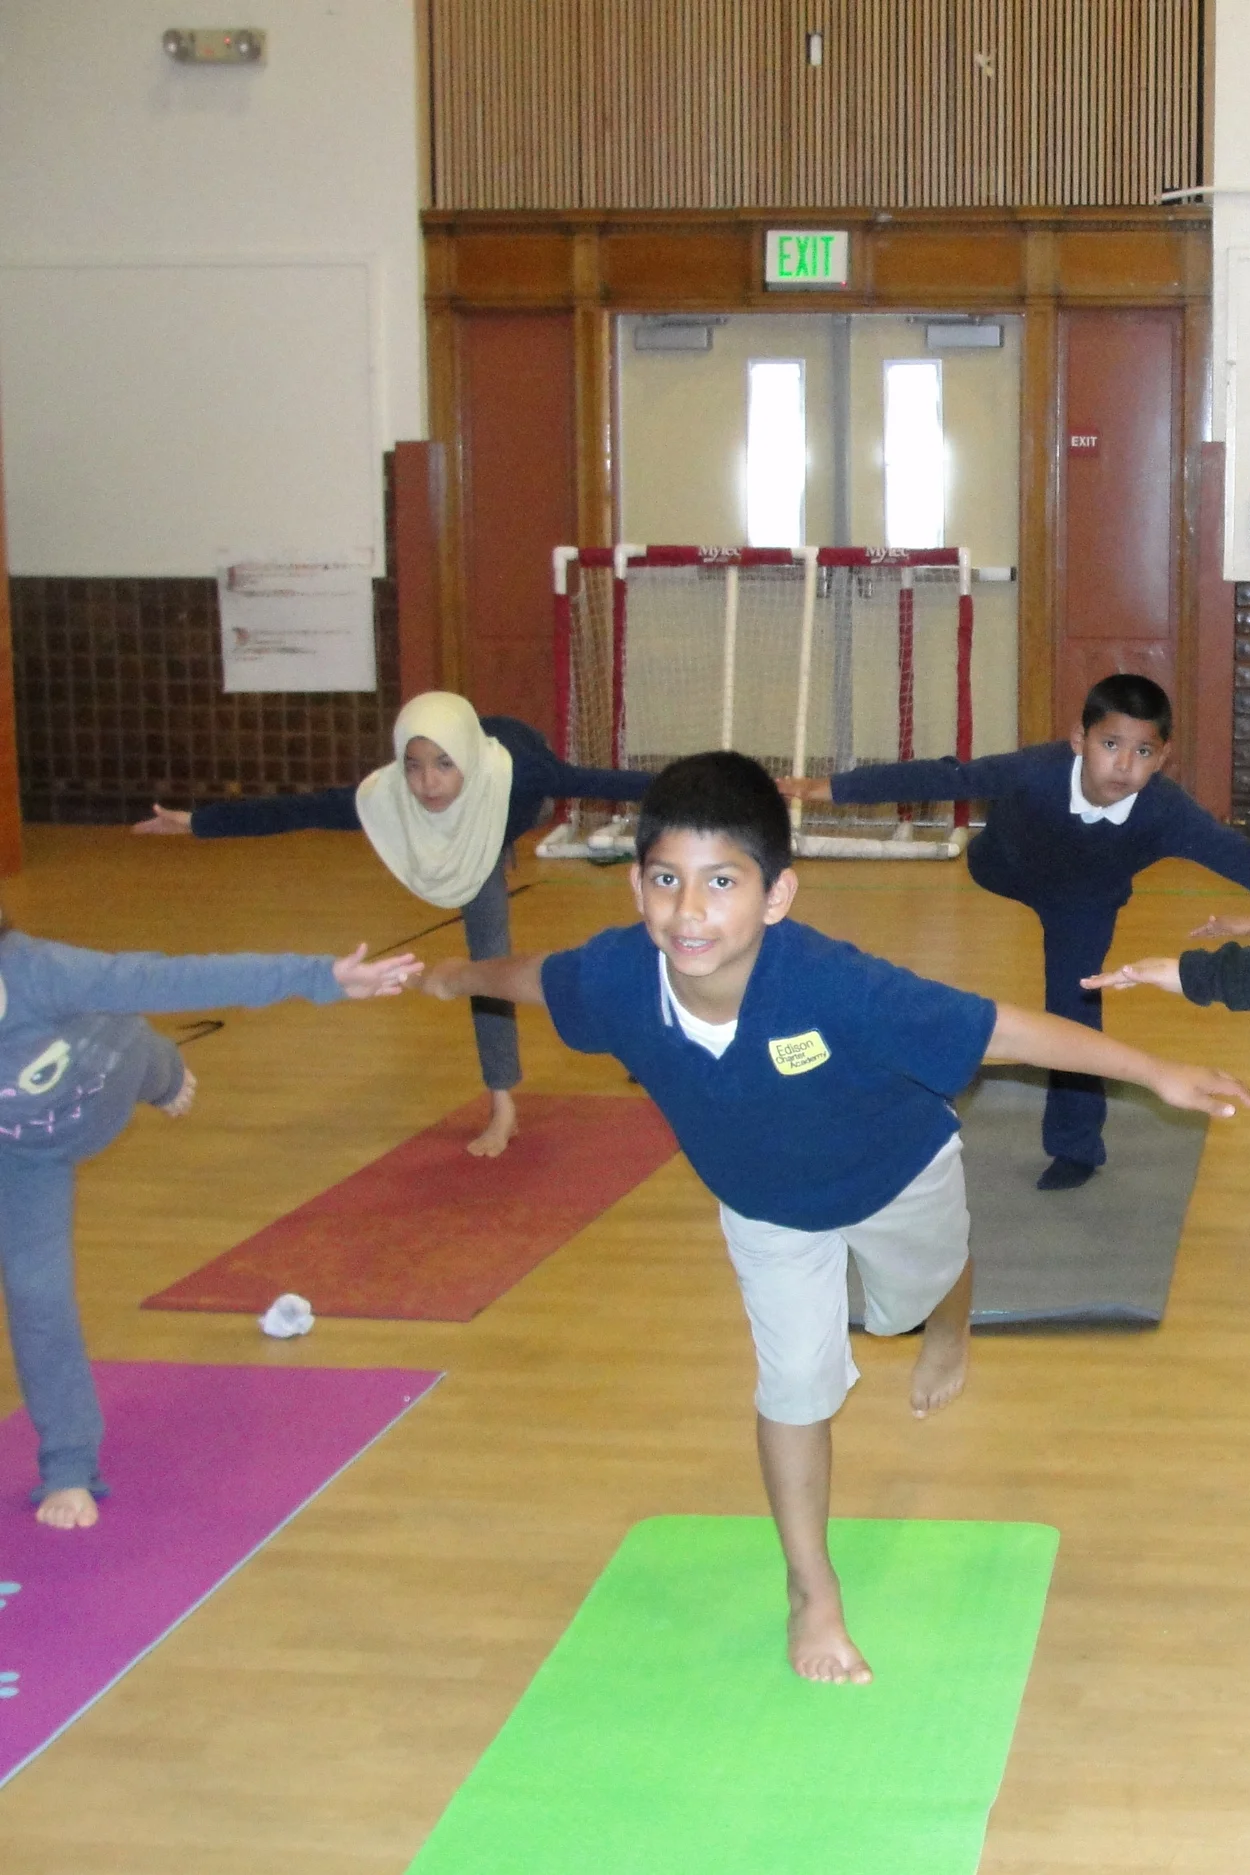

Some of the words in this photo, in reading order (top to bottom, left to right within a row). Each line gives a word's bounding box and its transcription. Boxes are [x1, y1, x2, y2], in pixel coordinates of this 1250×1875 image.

[778, 236, 835, 277] EXIT
[1071, 435, 1098, 447] EXIT
[776, 1040, 814, 1057] Edison
